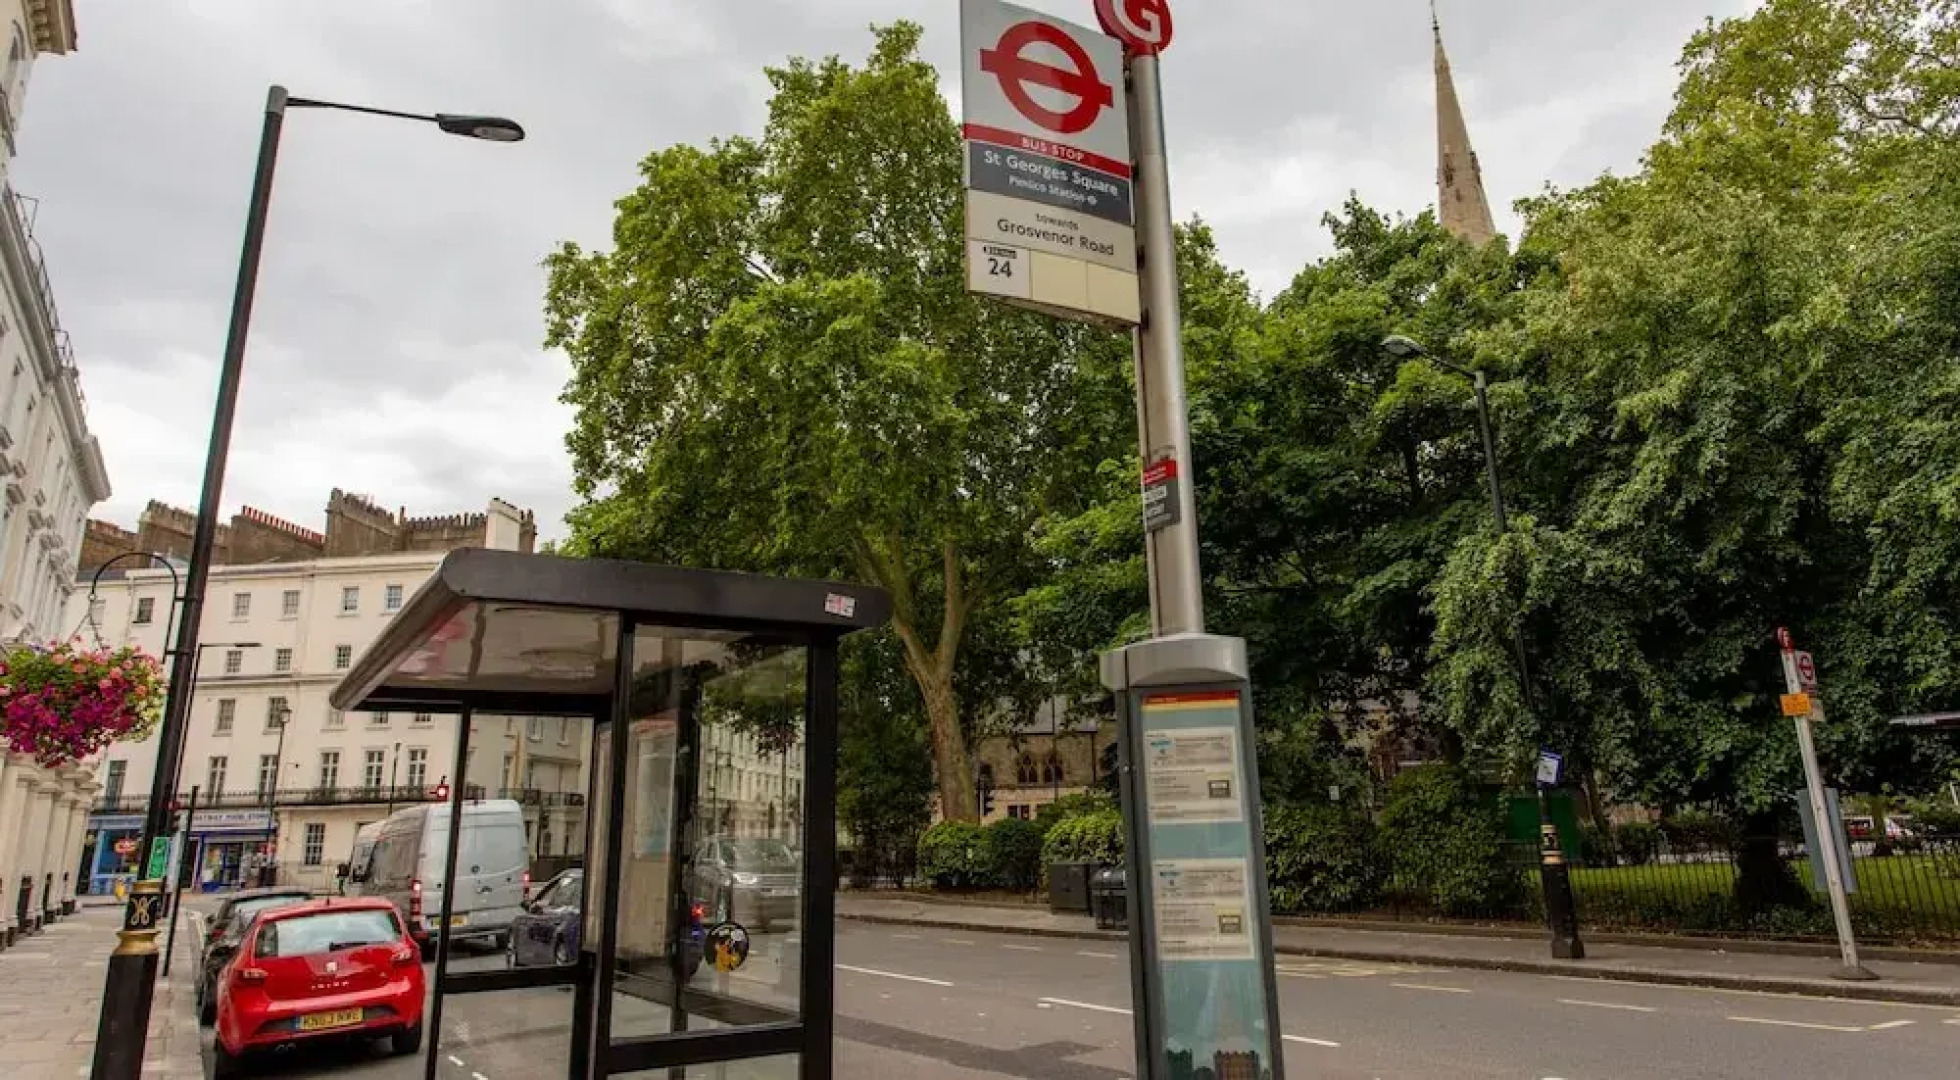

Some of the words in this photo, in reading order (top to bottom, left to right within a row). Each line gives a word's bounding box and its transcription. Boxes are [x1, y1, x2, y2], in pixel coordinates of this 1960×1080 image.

[1111, 0, 1162, 42] G
[1021, 136, 1048, 153] BUS
[1051, 144, 1085, 162] STOP
[984, 150, 1001, 166] St
[1006, 154, 1069, 182] Georges
[1071, 170, 1118, 197] Square
[1008, 175, 1048, 193] Pimlico
[1048, 183, 1085, 203] Station
[1035, 212, 1079, 231] towards
[997, 218, 1075, 246] Grosvenor
[1079, 235, 1114, 256] Road
[987, 257, 1013, 278] 24
